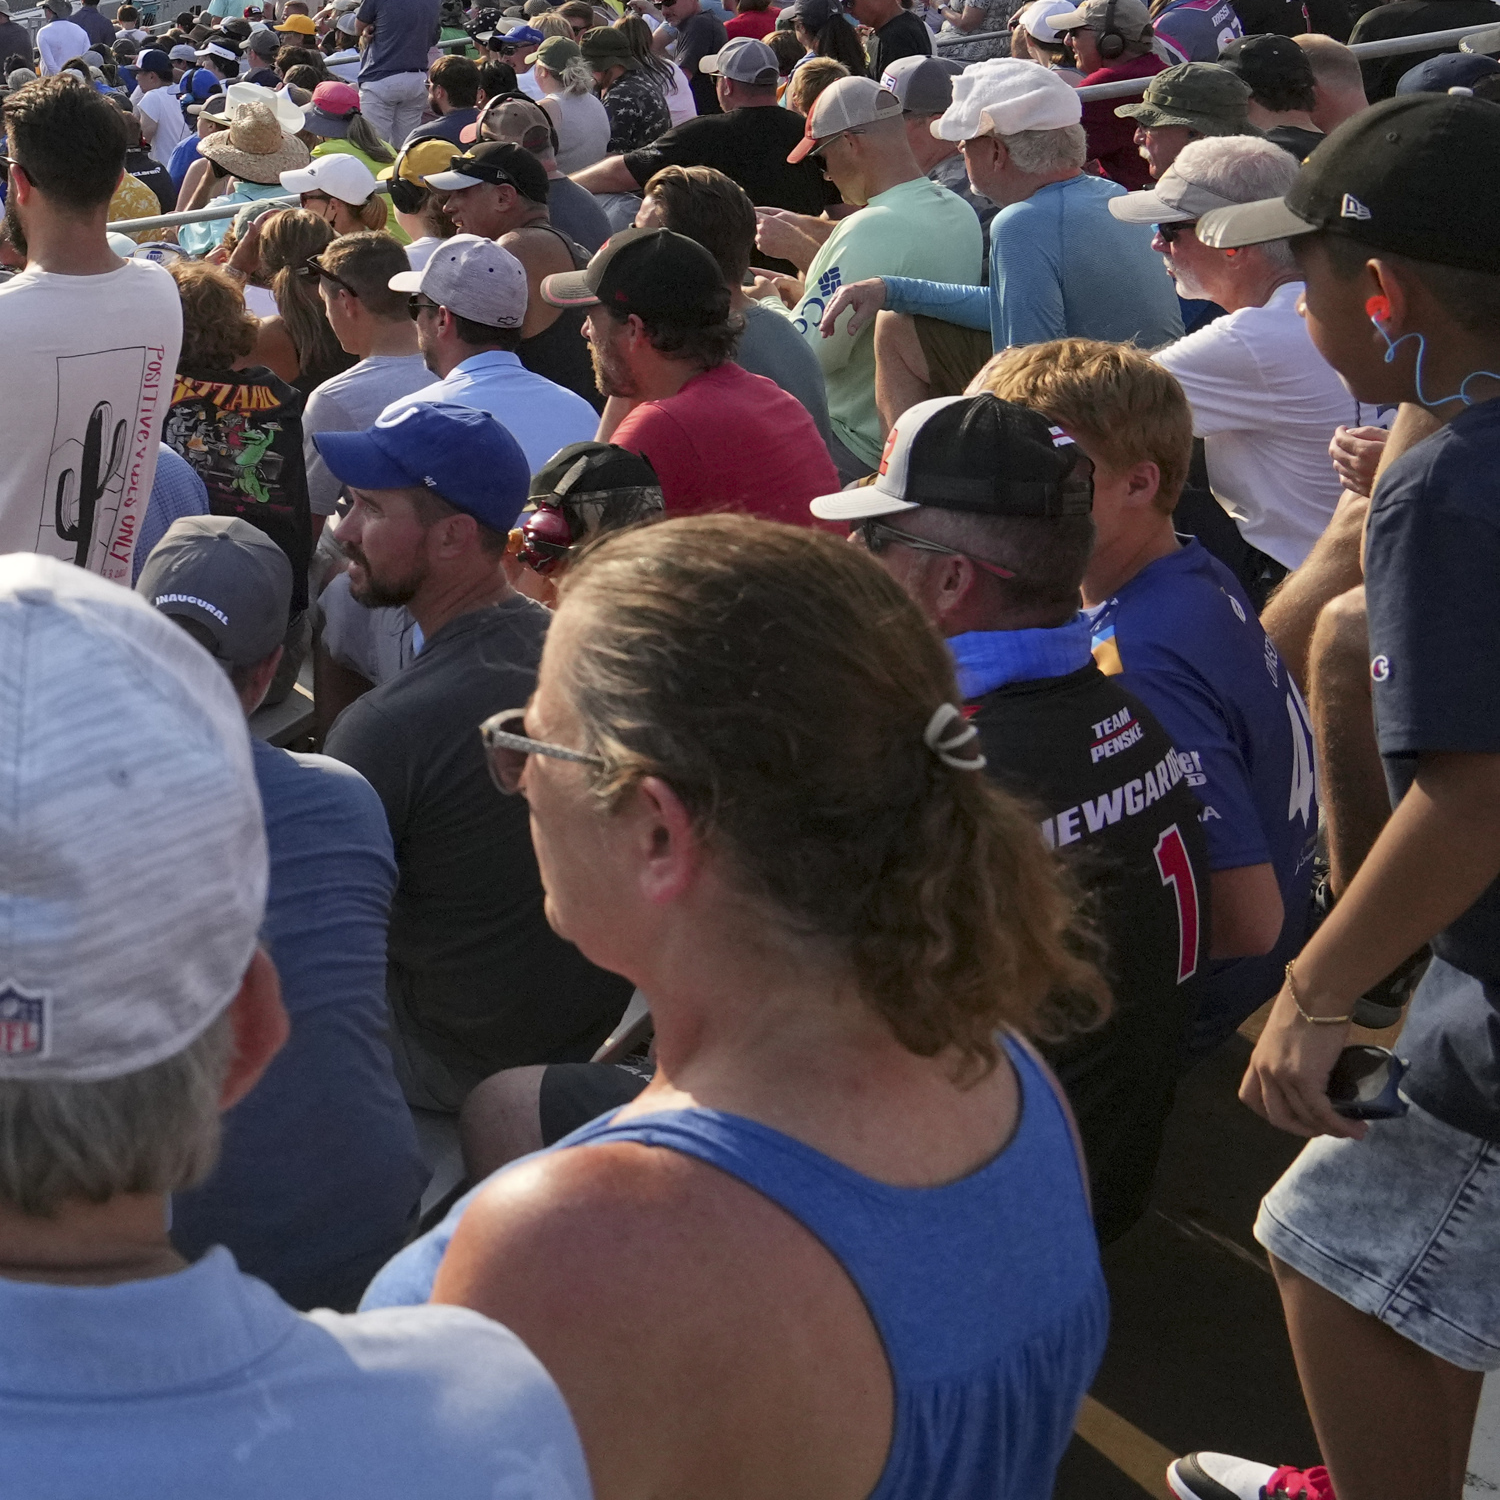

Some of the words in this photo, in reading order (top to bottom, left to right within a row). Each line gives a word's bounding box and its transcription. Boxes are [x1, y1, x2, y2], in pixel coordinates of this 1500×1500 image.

[108, 514, 137, 564] ONLY
[155, 592, 229, 627] INAUGURAL
[1089, 721, 1145, 764] PENSKE
[1091, 706, 1132, 740] TEAM
[1152, 822, 1200, 986] 1
